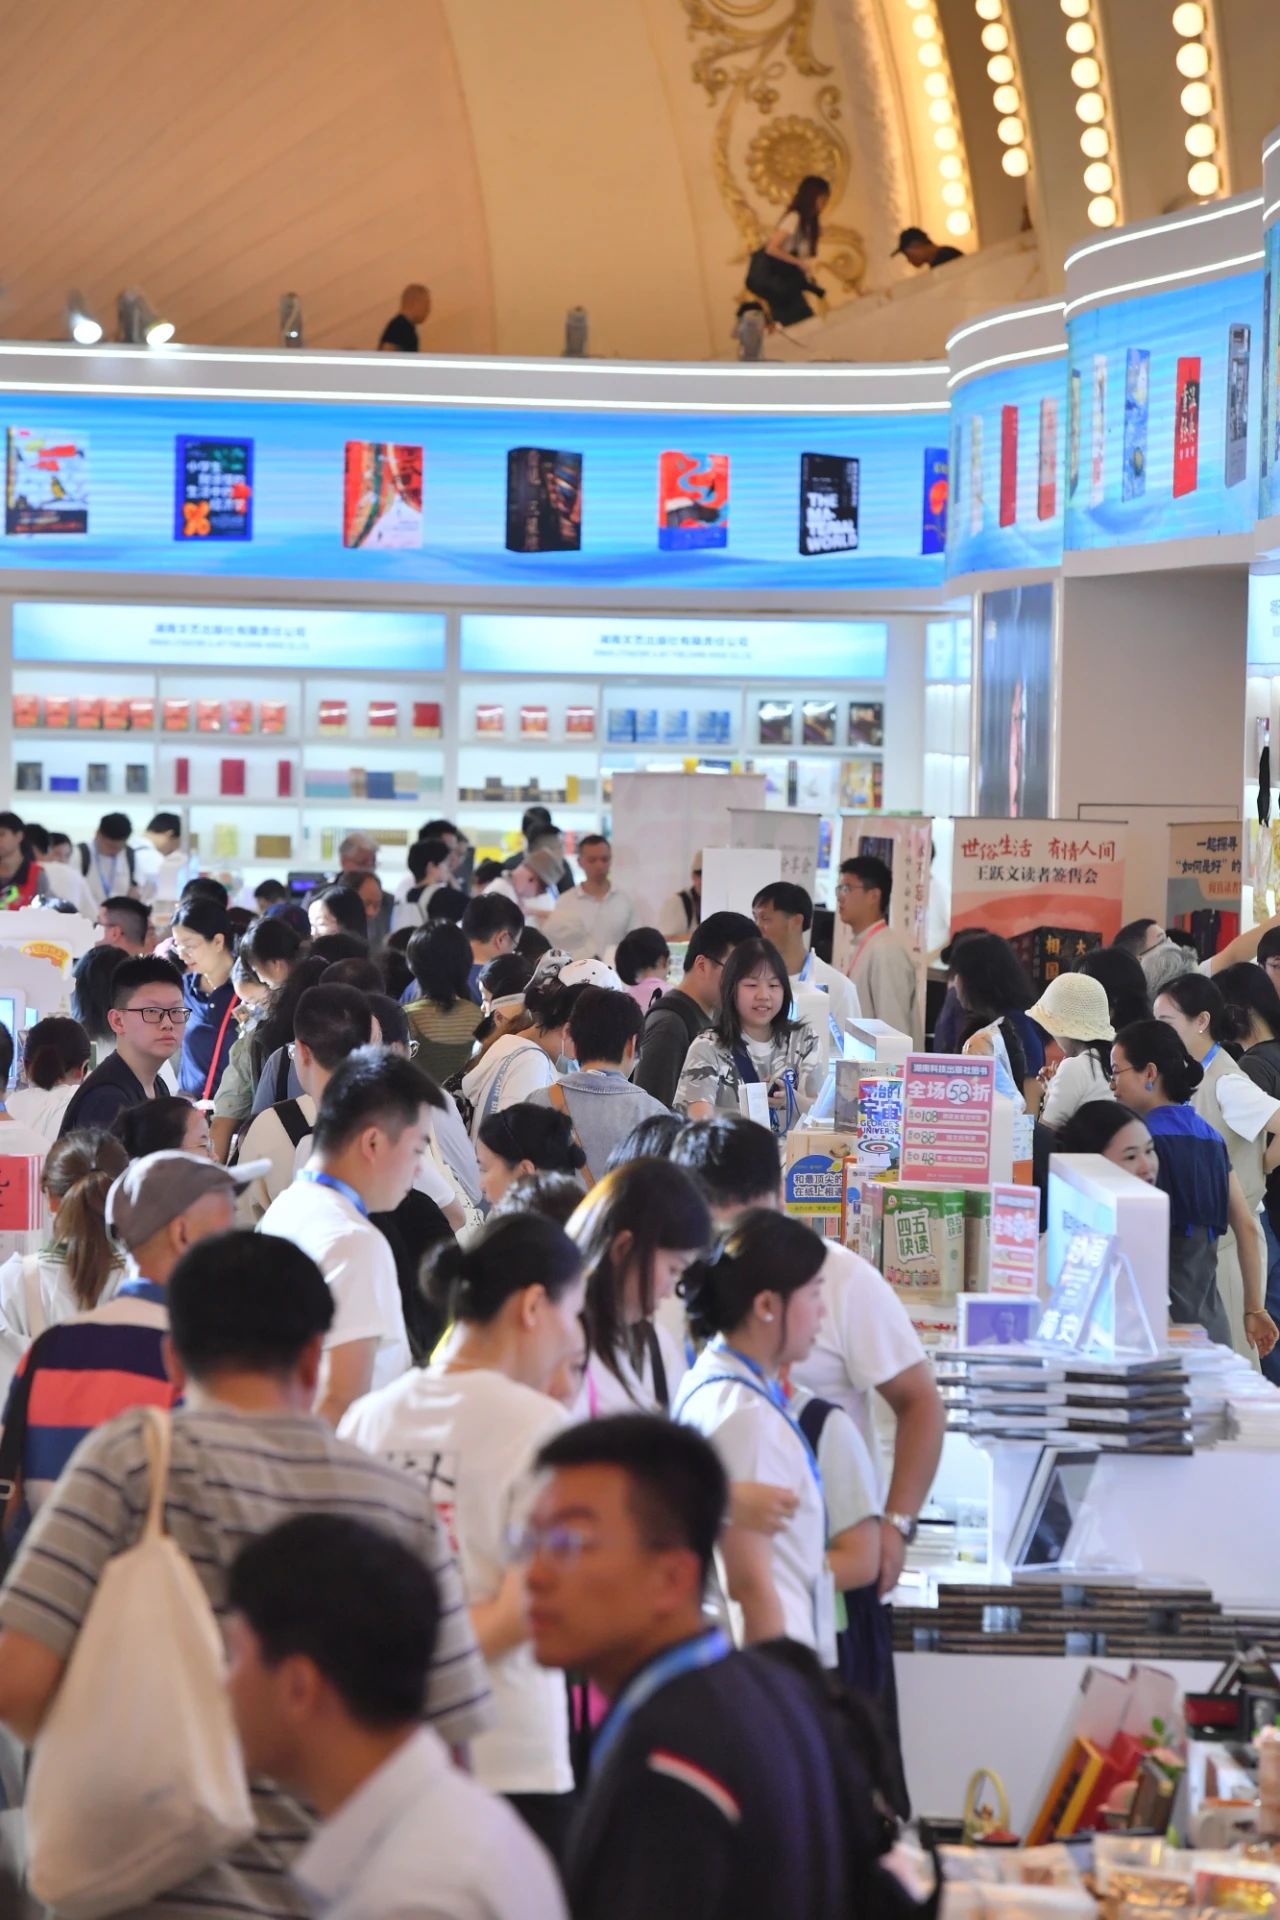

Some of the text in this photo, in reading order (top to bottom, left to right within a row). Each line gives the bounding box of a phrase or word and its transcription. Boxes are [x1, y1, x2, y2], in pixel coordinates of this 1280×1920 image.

[807, 492, 838, 509] THE
[806, 531, 858, 553] WORLD
[961, 833, 1116, 862] 世俗生活 有情人间
[976, 865, 1099, 885] 王跃文读者签售会
[913, 1063, 988, 1076] 湖南科技出版社图书
[860, 1119, 900, 1128] GEORGE'S
[794, 1174, 843, 1185] 和最顶尖的
[897, 1215, 927, 1237] 四五
[900, 1235, 931, 1257] 快读
